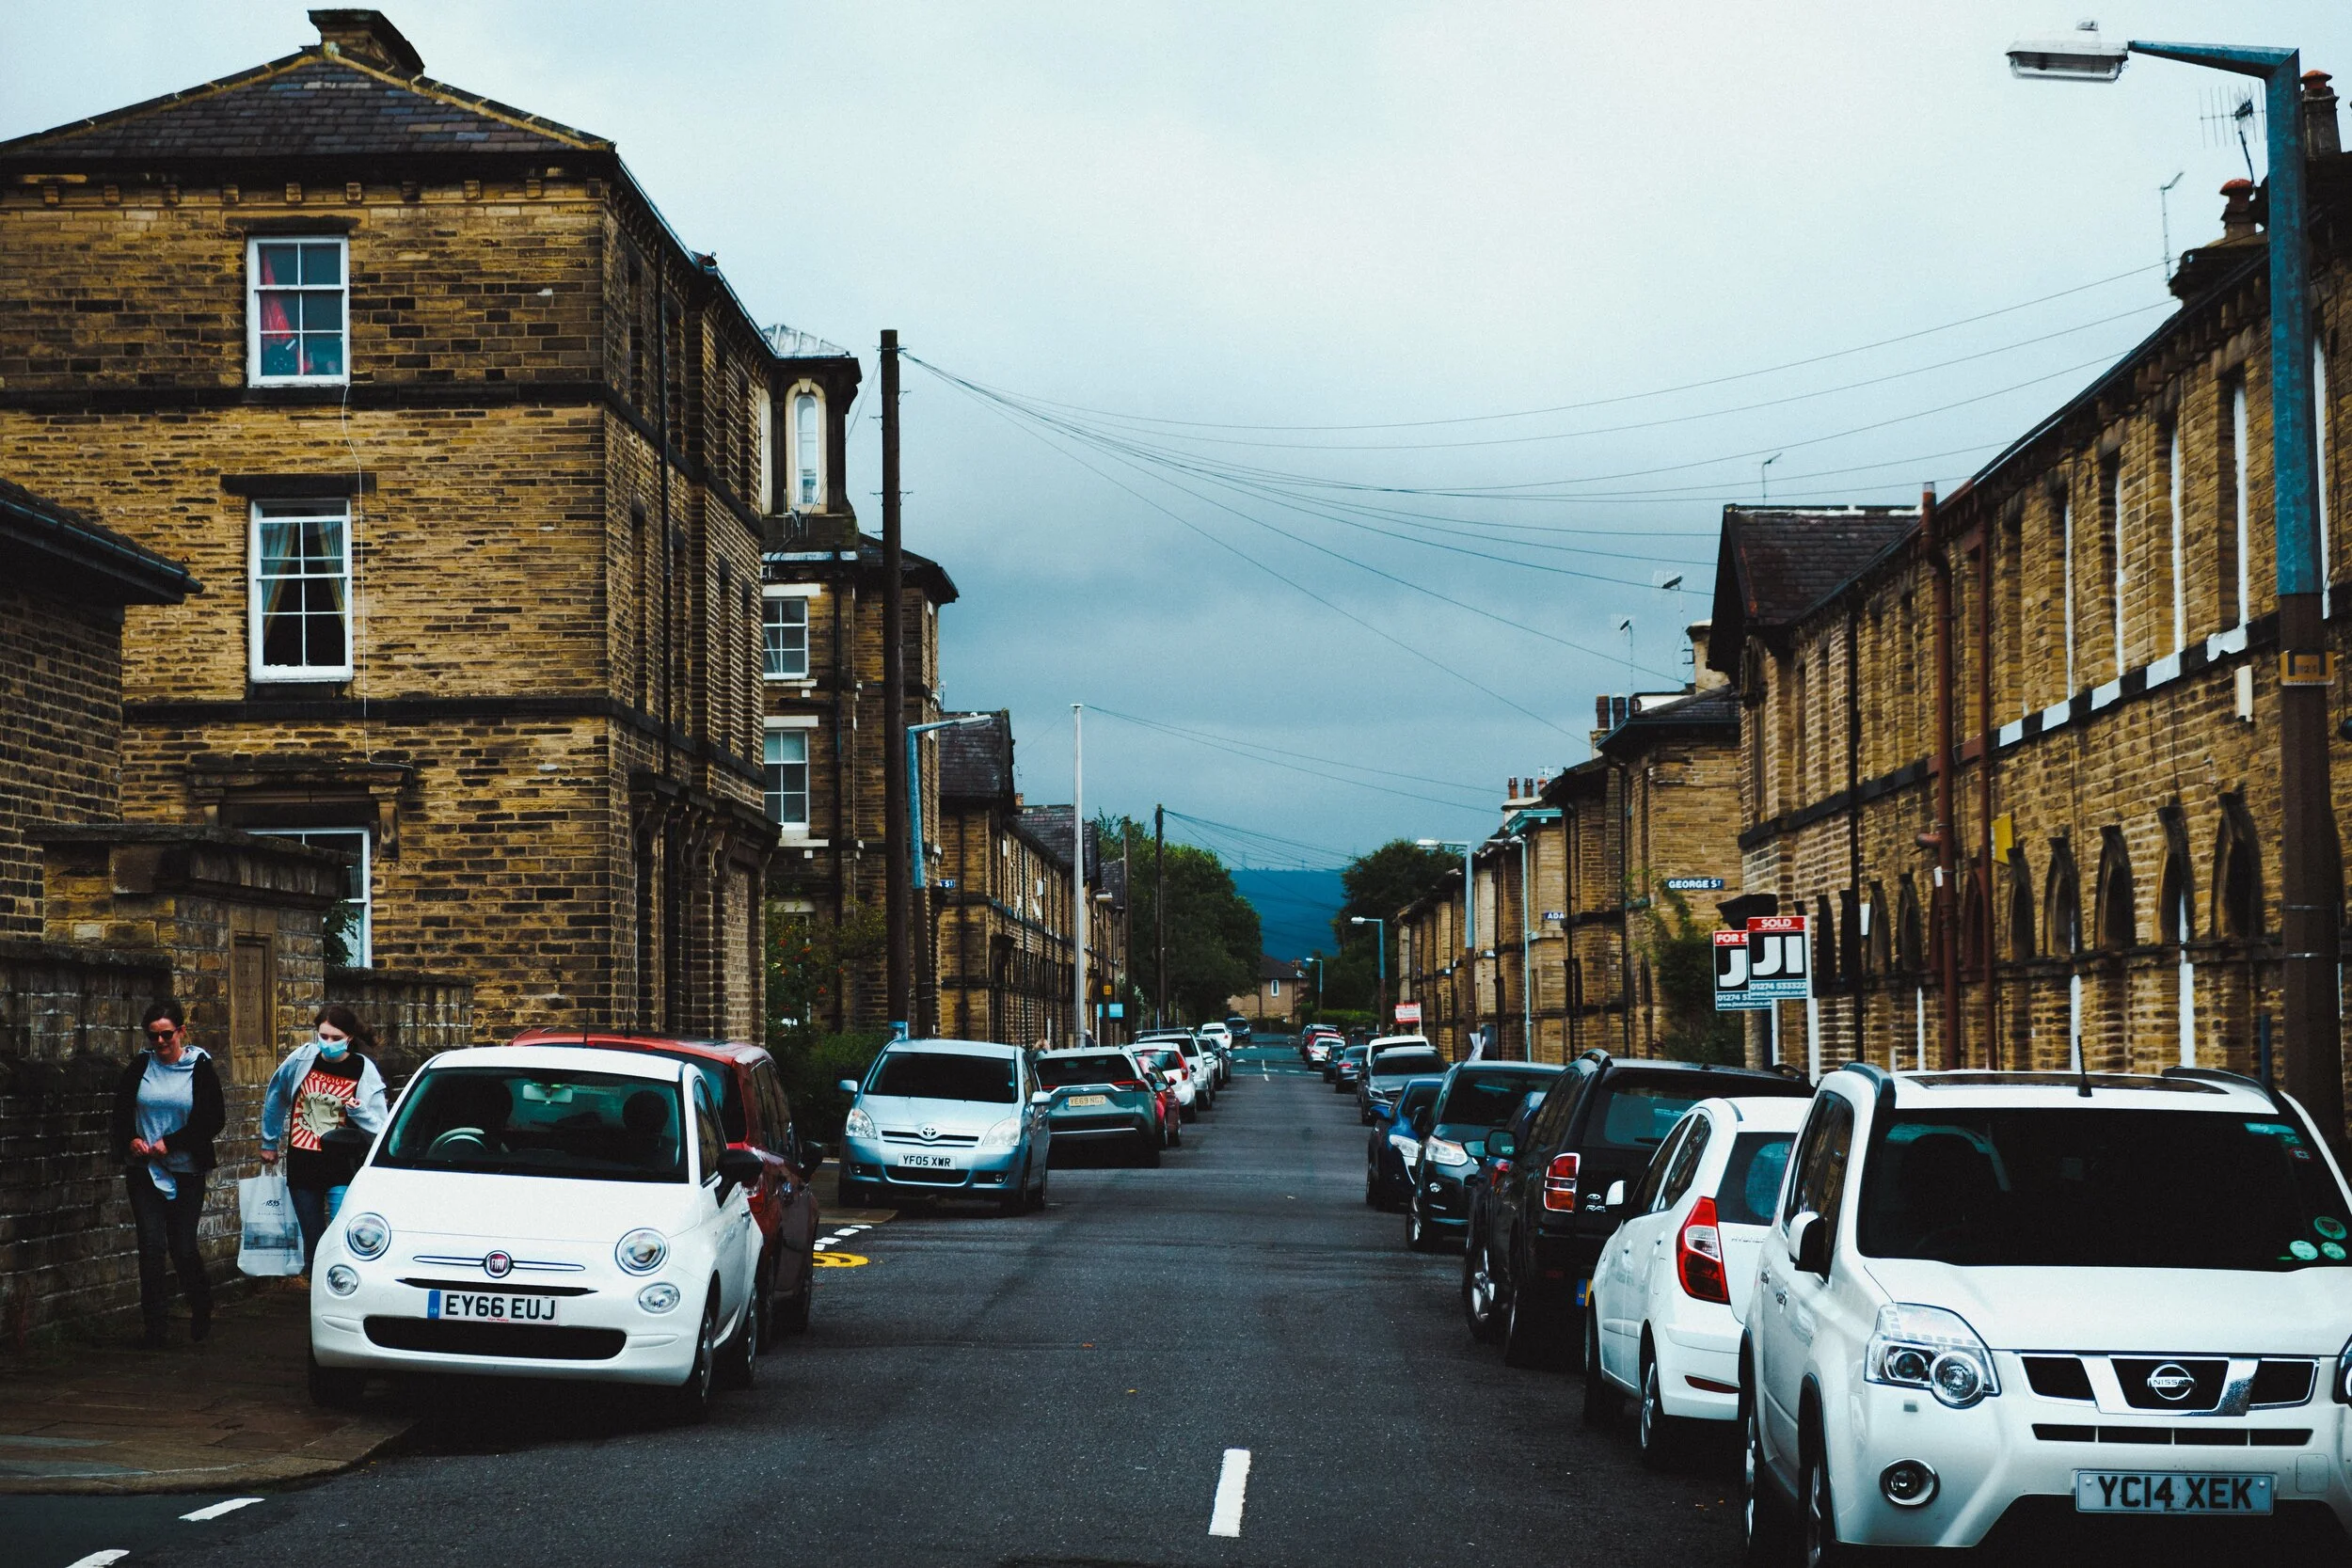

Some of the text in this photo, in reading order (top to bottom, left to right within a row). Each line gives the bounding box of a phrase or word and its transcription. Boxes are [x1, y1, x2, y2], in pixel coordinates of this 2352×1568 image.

[1668, 879, 1708, 889] GEORGE
[1761, 918, 1792, 928] SOLD
[1716, 934, 1739, 943] FOR
[1752, 936, 1804, 975] JI
[1719, 949, 1747, 987] J
[1750, 982, 1774, 990] 01274
[1717, 993, 1740, 1002] 01274
[310, 1071, 343, 1085] かわいい
[903, 1155, 951, 1166] YF05 XWR
[490, 1259, 506, 1270] FIAT
[445, 1294, 555, 1321] EY66 EUJ
[2098, 1476, 2252, 1509] YC14 XEK
